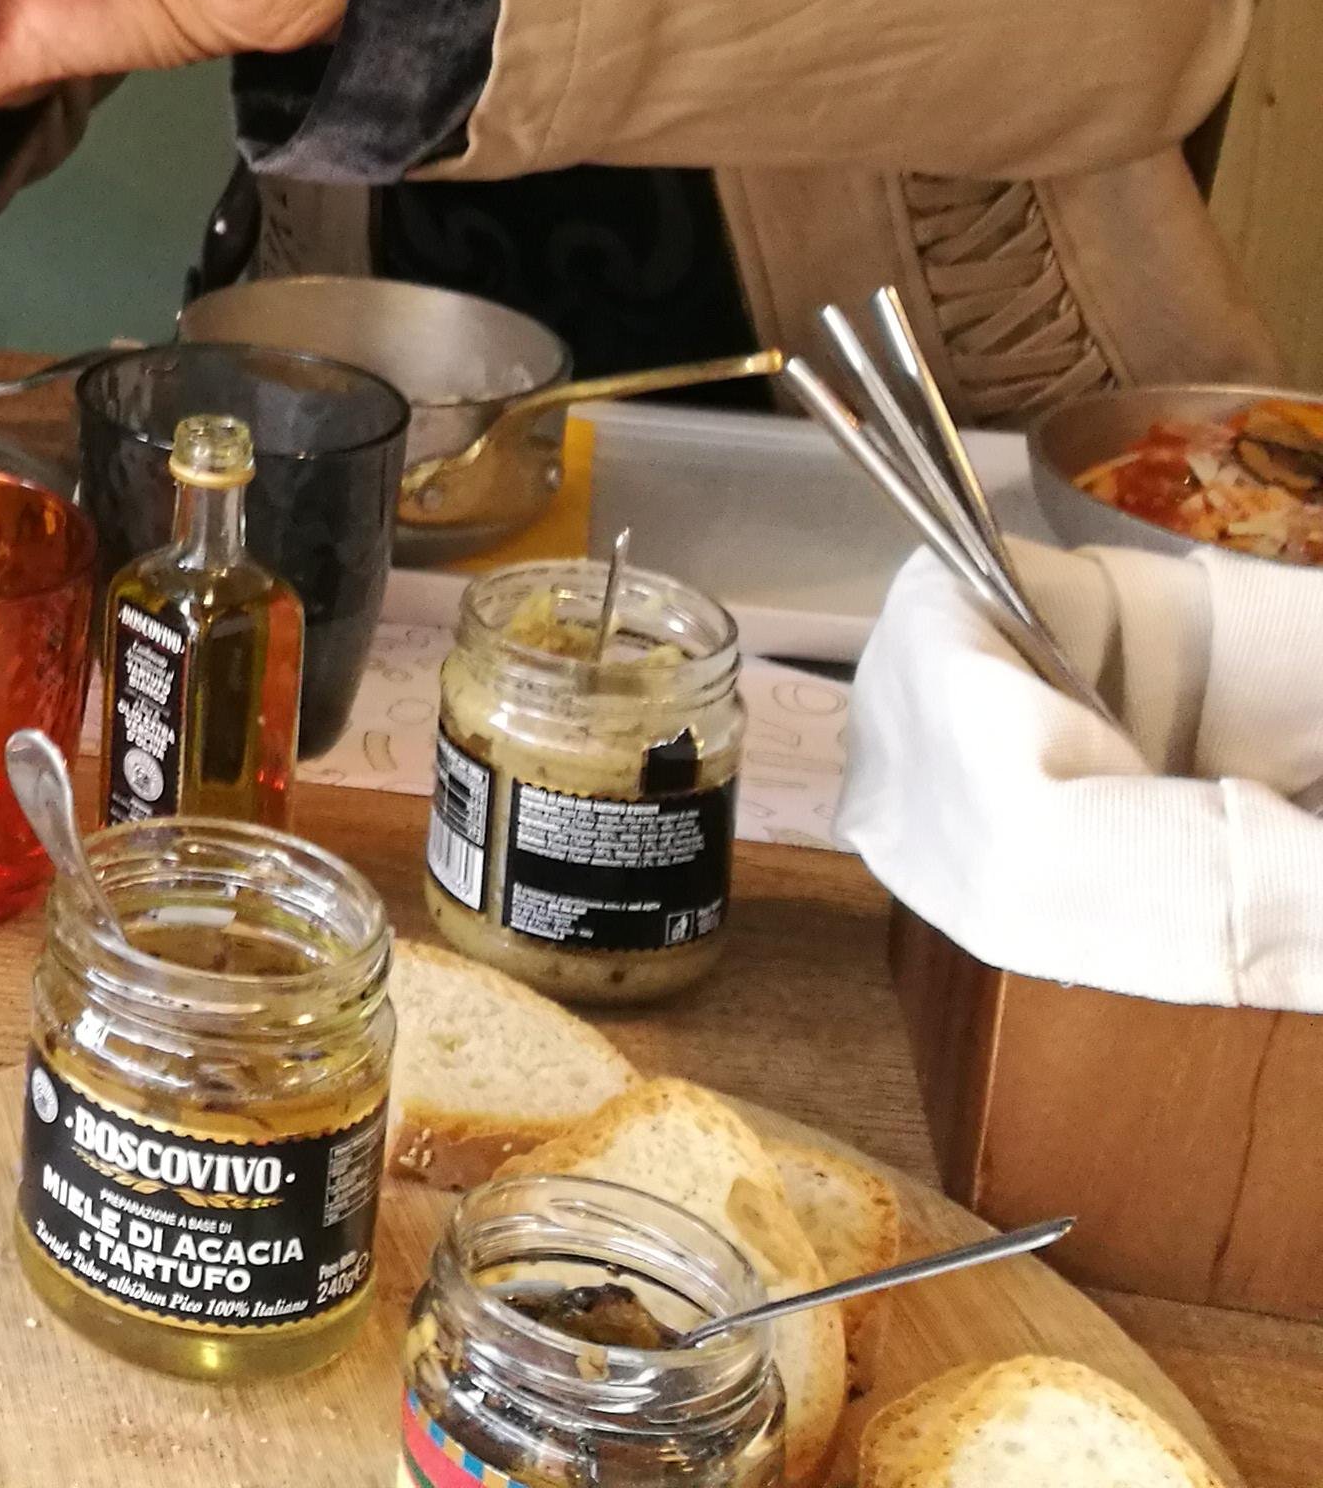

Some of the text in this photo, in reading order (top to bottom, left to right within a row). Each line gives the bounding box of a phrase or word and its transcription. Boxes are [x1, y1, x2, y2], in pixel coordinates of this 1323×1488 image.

[73, 1105, 282, 1195] BOSCOVIVO
[42, 1163, 304, 1266] MIELE DI ACACIA
[99, 1187, 233, 1235] PREPARAZIONE A BASE DI
[94, 1231, 251, 1294] TARTUFO
[205, 1298, 250, 1318] 100%
[251, 1298, 309, 1319] Italiano
